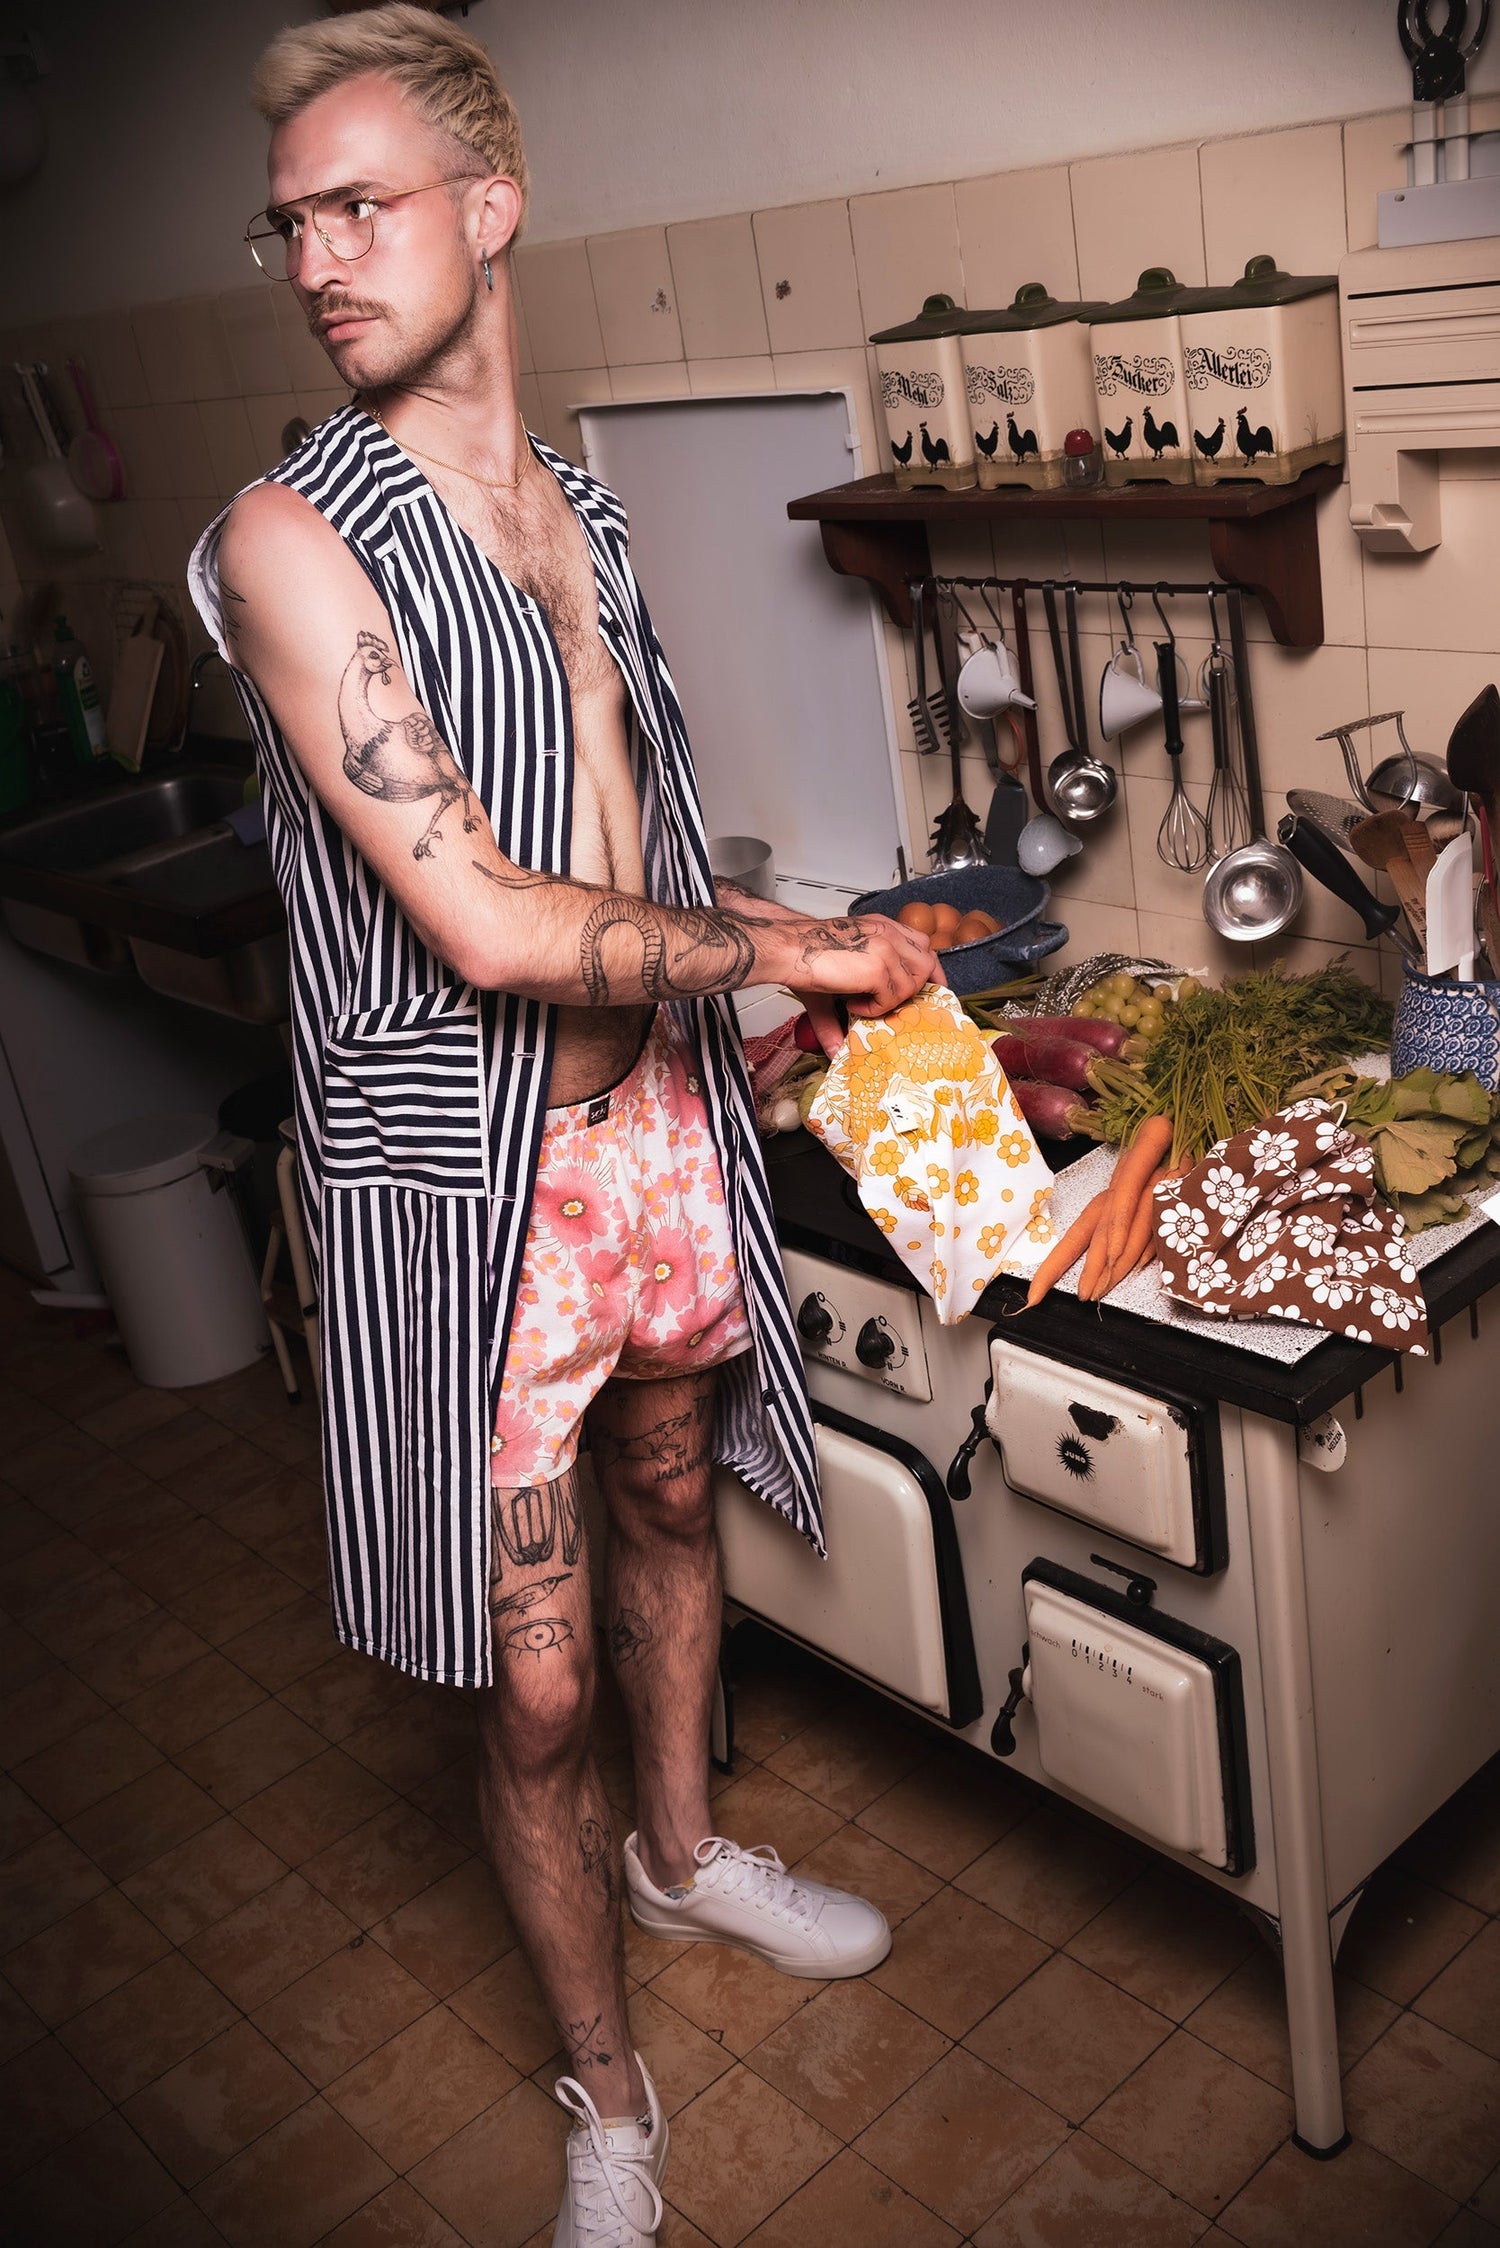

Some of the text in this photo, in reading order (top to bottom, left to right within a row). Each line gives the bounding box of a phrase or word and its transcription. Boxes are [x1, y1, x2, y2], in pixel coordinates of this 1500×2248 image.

[1111, 355, 1159, 393] Zucker
[1199, 348, 1253, 386] Allerlei
[896, 372, 928, 405] Mehl
[985, 371, 1014, 403] Salz
[881, 1377, 899, 1390] VORN
[1327, 1430, 1343, 1453] HEIZEN
[1064, 1450, 1086, 1464] JUNO
[655, 1464, 684, 1482] JACK
[1072, 1648, 1132, 1685] 0 1 2 3 4
[1142, 1686, 1164, 1701] stark
